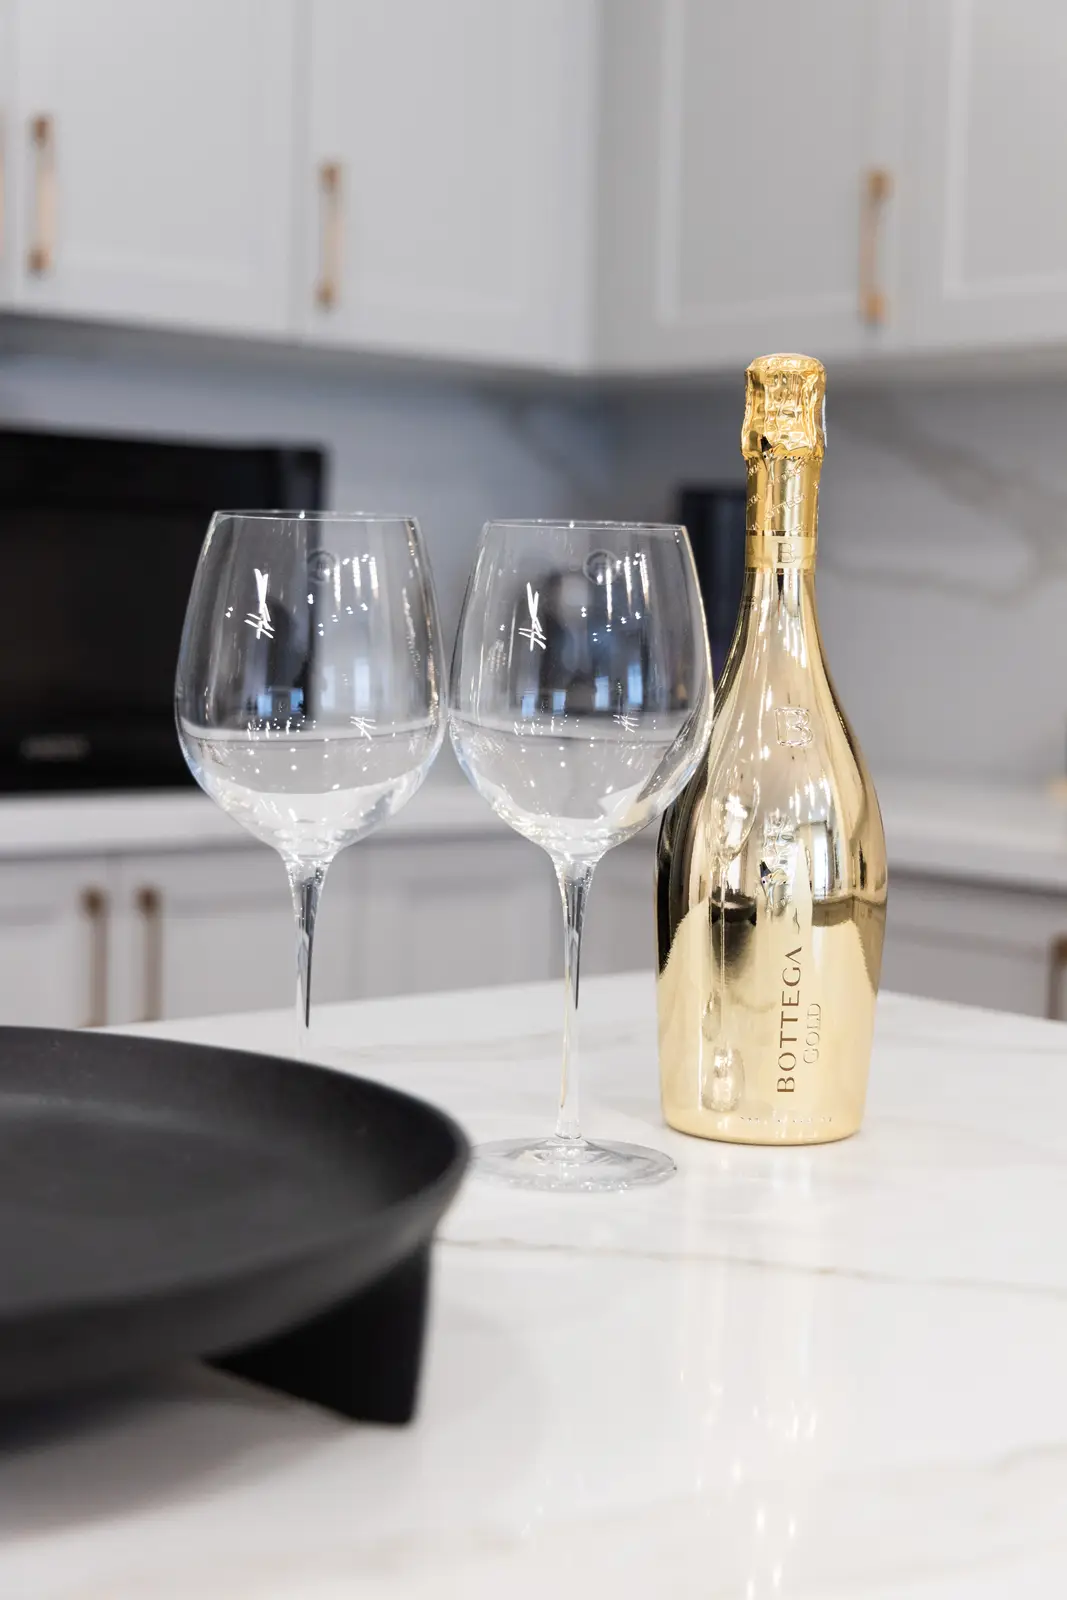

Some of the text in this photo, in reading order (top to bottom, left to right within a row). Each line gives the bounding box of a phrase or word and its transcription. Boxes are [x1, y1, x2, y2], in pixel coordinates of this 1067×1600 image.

[777, 542, 797, 564] B
[774, 707, 813, 748] B
[777, 946, 803, 1093] BOTTEGA
[803, 1003, 821, 1064] GOLD
